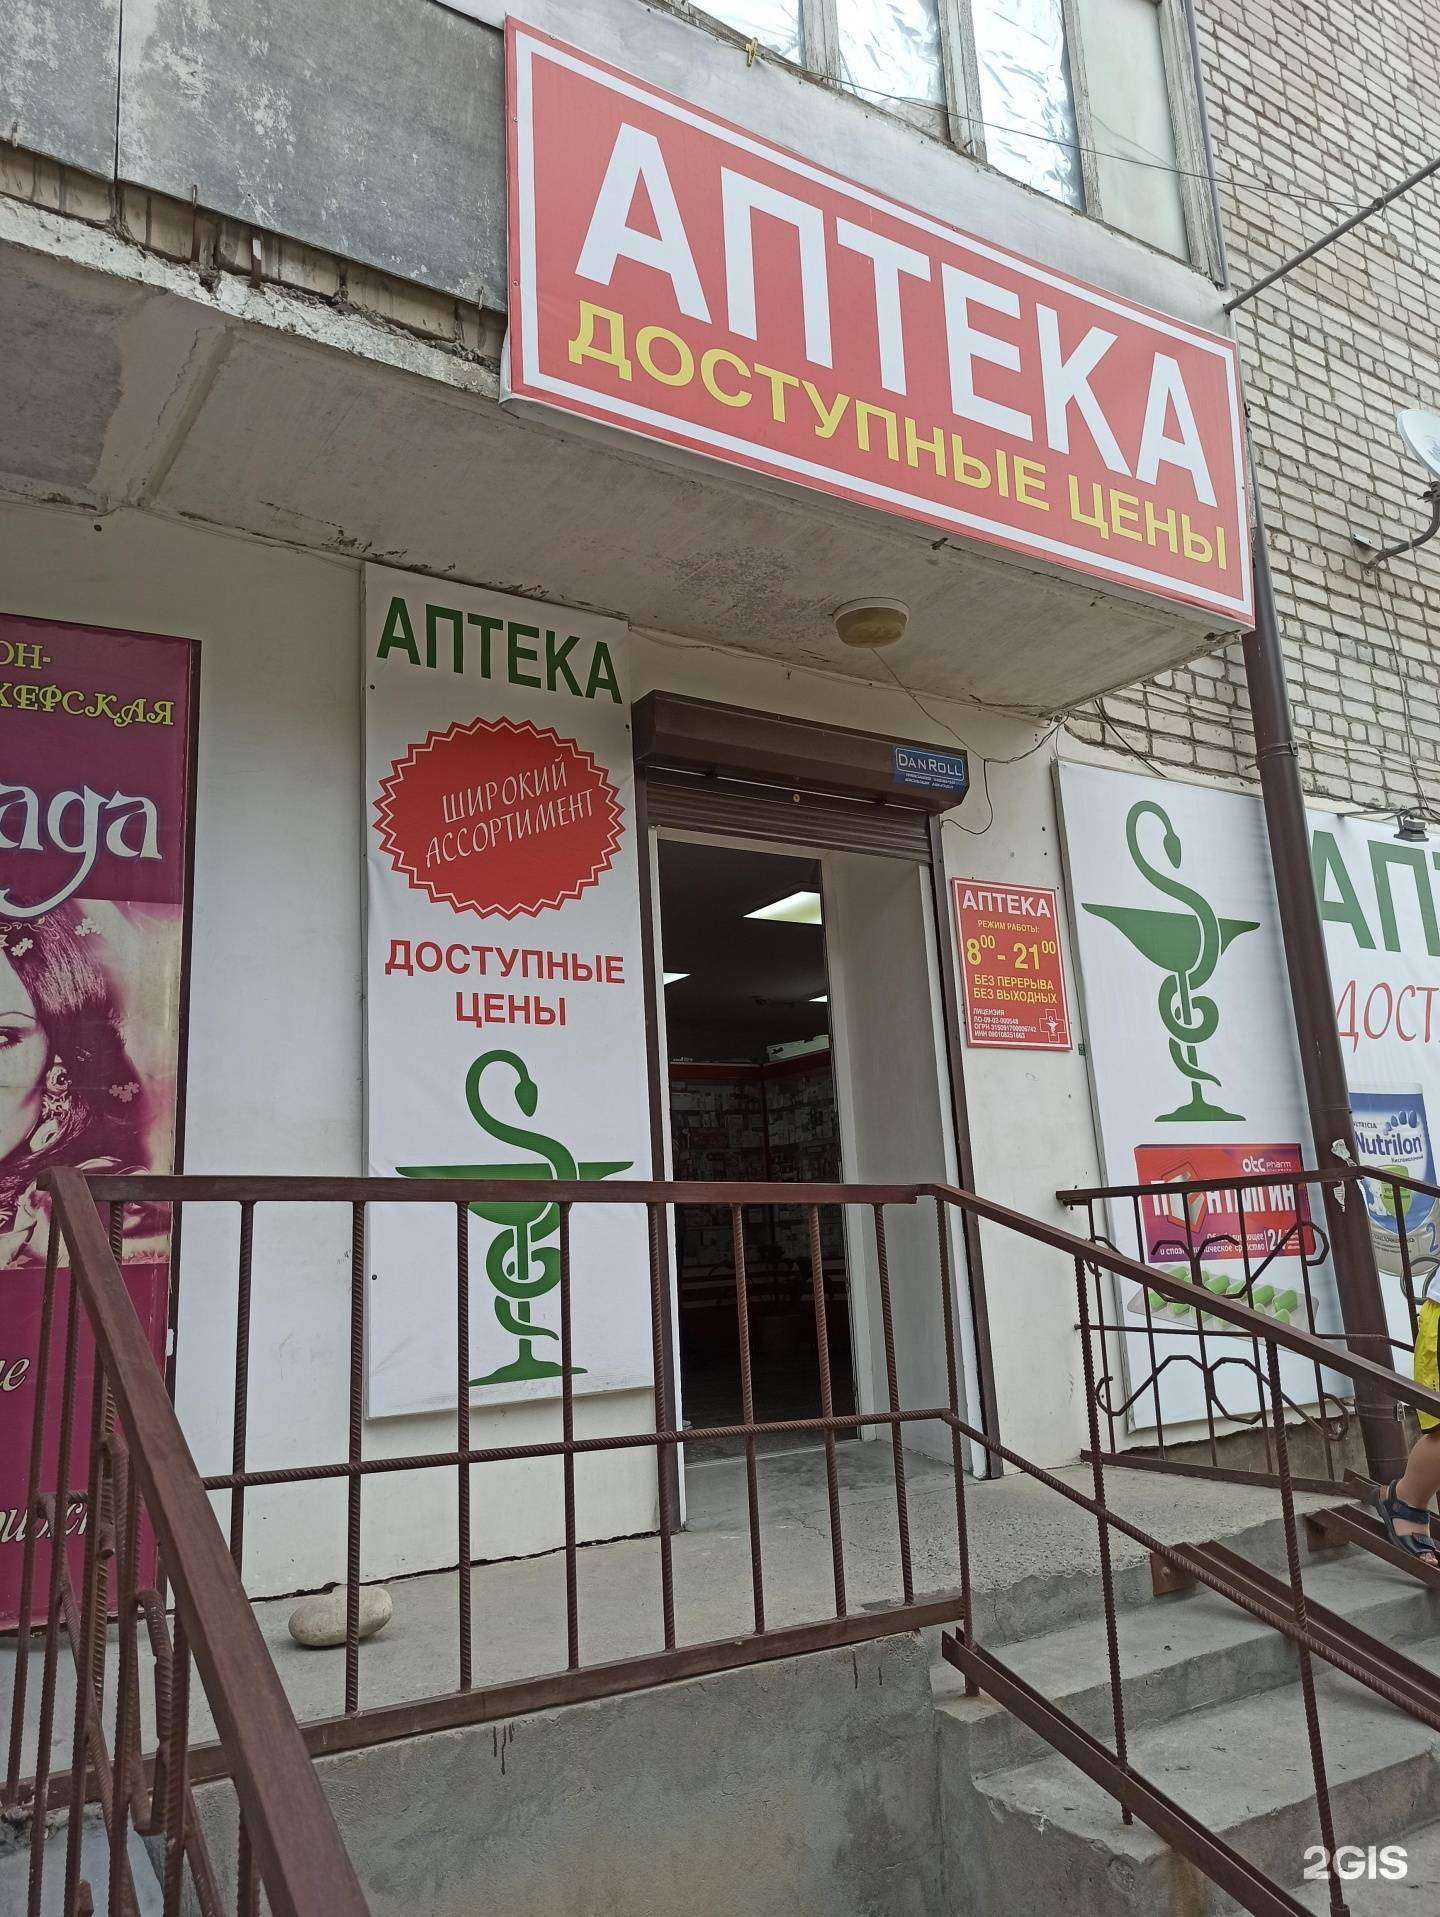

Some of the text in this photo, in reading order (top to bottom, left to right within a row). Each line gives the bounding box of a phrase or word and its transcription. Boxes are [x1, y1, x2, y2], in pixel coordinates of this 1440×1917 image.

[574, 121, 1218, 507] АПТЕКА
[568, 300, 1228, 570] ДОСТУПНЫЕ ЦЕНЫ
[376, 596, 624, 705] АПТЕКА
[441, 754, 568, 824] ШИРОКИЙ
[425, 789, 597, 870] АССОРТИМЕНТ
[962, 889, 1051, 918] АПТЕКА
[977, 919, 1040, 933] РЕЖИМ РАБОТЫ:
[385, 939, 626, 985] ДОСТУПНЫЕ
[973, 974, 1054, 990] БЕЗ ПЕРЕРЫВА
[456, 992, 568, 1029] ЦЕНЫ
[973, 987, 1058, 1004] БЕЗ ВЫХОДНЫХ
[1355, 1131, 1423, 1156] Nutrilon
